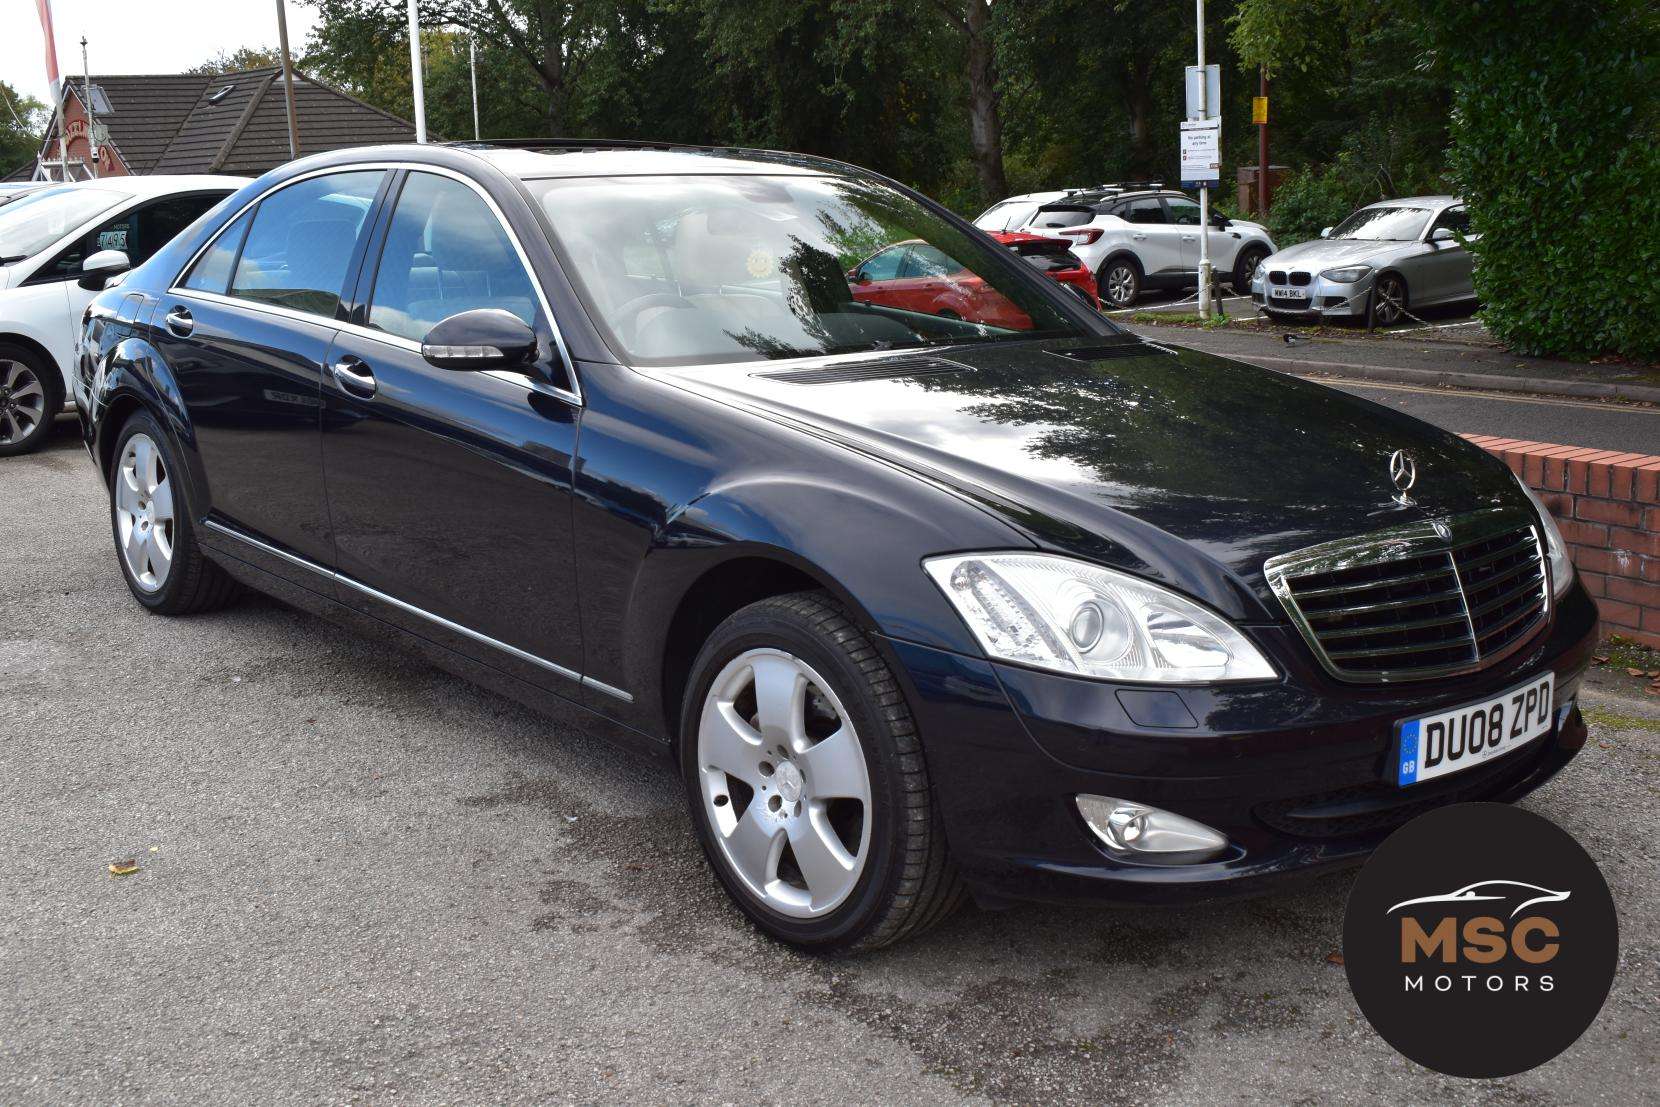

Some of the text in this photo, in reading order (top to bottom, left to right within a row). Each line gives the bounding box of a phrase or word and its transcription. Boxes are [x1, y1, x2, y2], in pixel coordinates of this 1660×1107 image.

[1424, 680, 1550, 769] DU08 ZPD
[1402, 760, 1415, 774] GB
